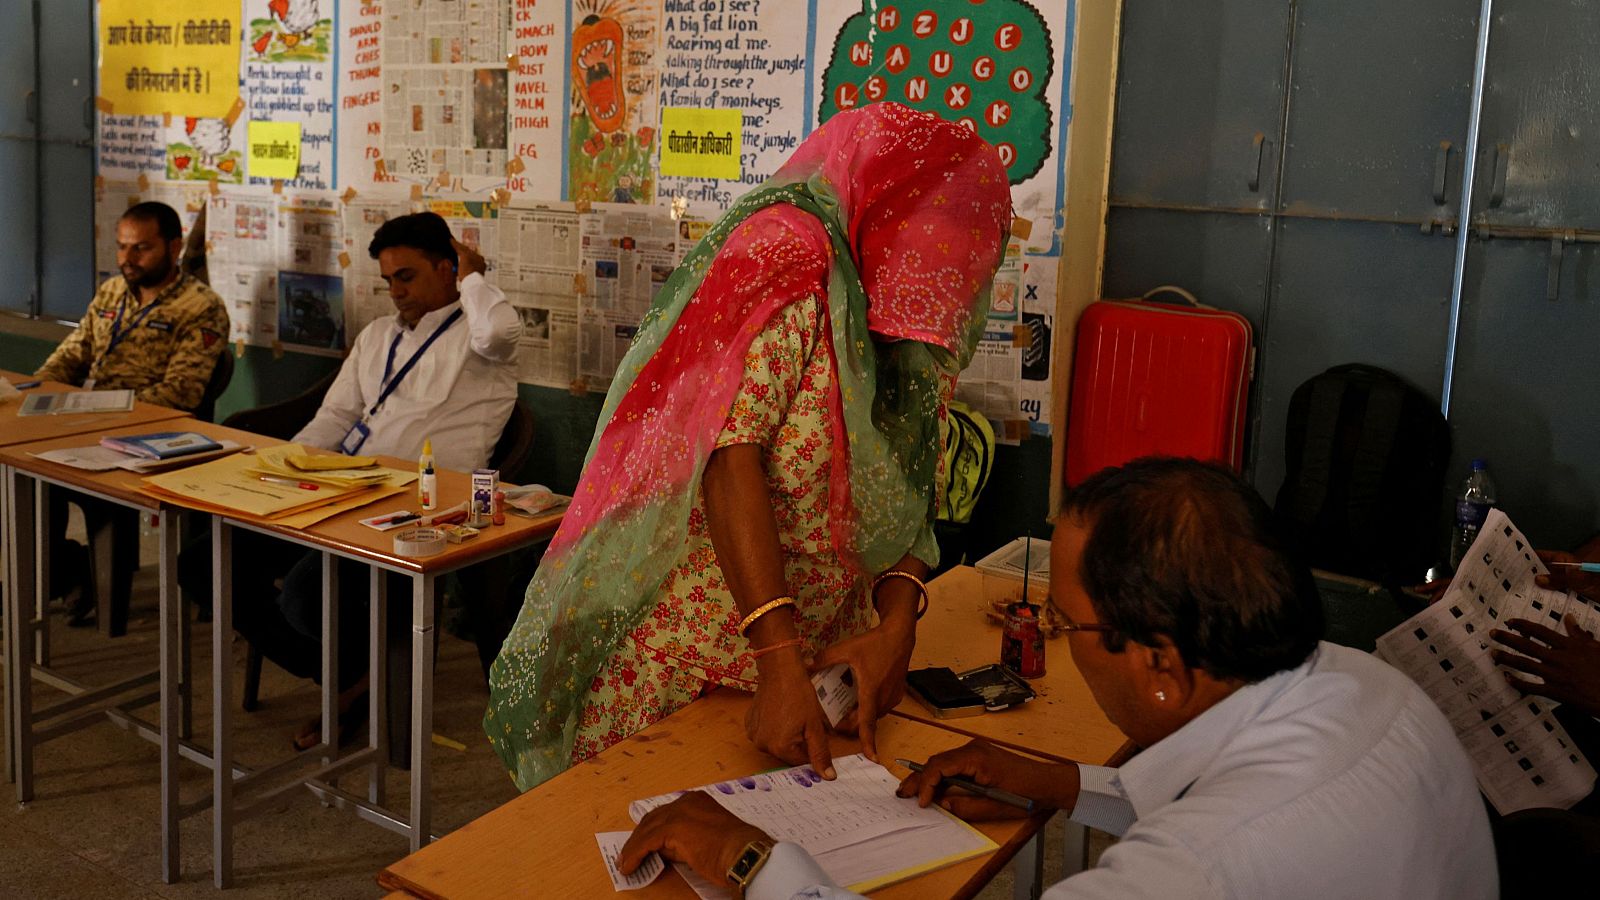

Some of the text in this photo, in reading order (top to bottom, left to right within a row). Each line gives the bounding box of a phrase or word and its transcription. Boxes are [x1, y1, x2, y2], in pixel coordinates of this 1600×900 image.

[665, 0, 695, 12] What
[699, 0, 717, 11] do
[665, 13, 758, 36] A big fat lion
[880, 11, 896, 28] H
[916, 15, 932, 34] Z
[952, 18, 970, 41] J
[1000, 26, 1014, 48] E
[667, 35, 721, 54] Roaring
[724, 33, 740, 49] at
[515, 62, 545, 76] RIST
[704, 53, 750, 75] through
[751, 54, 768, 70] the
[934, 54, 949, 73] U
[975, 58, 990, 78] G
[660, 71, 690, 89] What
[693, 73, 709, 88] do
[869, 79, 881, 97] S
[909, 80, 926, 99] N
[660, 91, 668, 106] A
[704, 91, 720, 109] of
[840, 87, 854, 106] L
[949, 87, 965, 106] X
[992, 104, 1009, 124] K
[699, 131, 732, 156] अधिकारी
